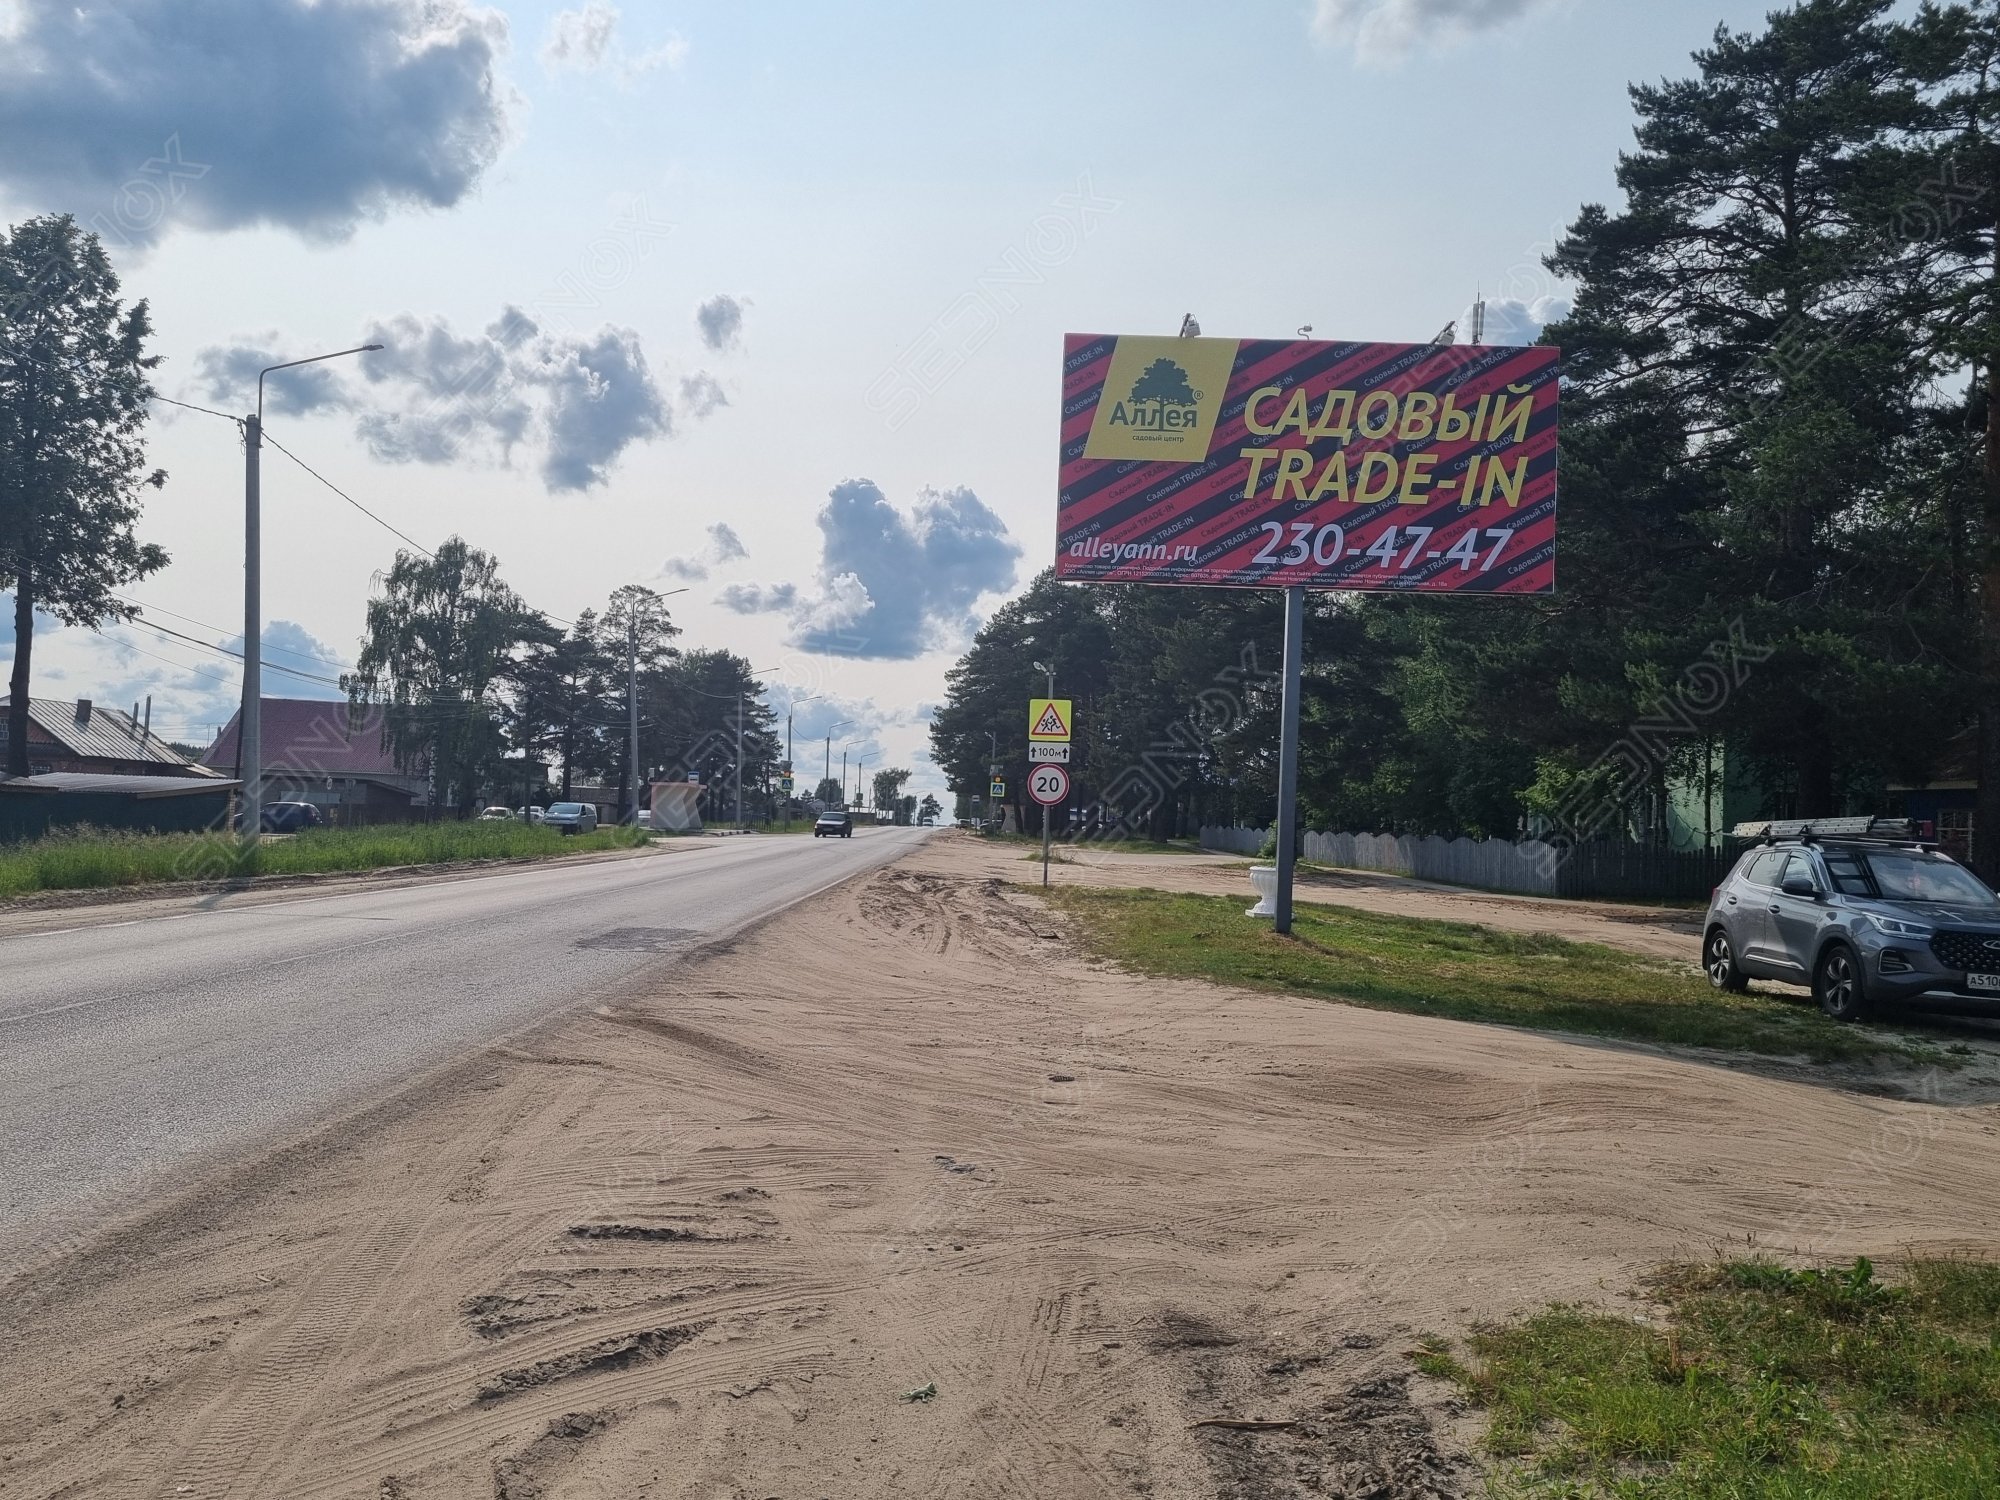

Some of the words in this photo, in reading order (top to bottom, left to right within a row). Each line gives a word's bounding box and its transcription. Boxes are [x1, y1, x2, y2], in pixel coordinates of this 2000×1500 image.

[1364, 364, 1399, 386] Садовый
[1397, 345, 1436, 369] TRADE-IN
[1109, 401, 1198, 429] Аллея
[1244, 383, 1535, 445] САДОВЫЙ
[1132, 433, 1162, 442] садовый
[1163, 435, 1184, 445] центр
[1147, 479, 1181, 502] Садовый
[1179, 460, 1218, 485] TRADE-IN
[1240, 448, 1529, 508] TRADE-IN
[1137, 503, 1175, 527] TRADE-IN
[1342, 506, 1377, 530] Садовый
[1156, 515, 1195, 542] TRADE-IN
[1221, 525, 1260, 551] TRADE-IN
[1070, 537, 1198, 563] alleyann.ru
[1252, 521, 1514, 572] 230-47-47
[1507, 553, 1543, 575] Садовый
[1038, 747, 1062, 757] 100м
[1036, 777, 1059, 792] 20
